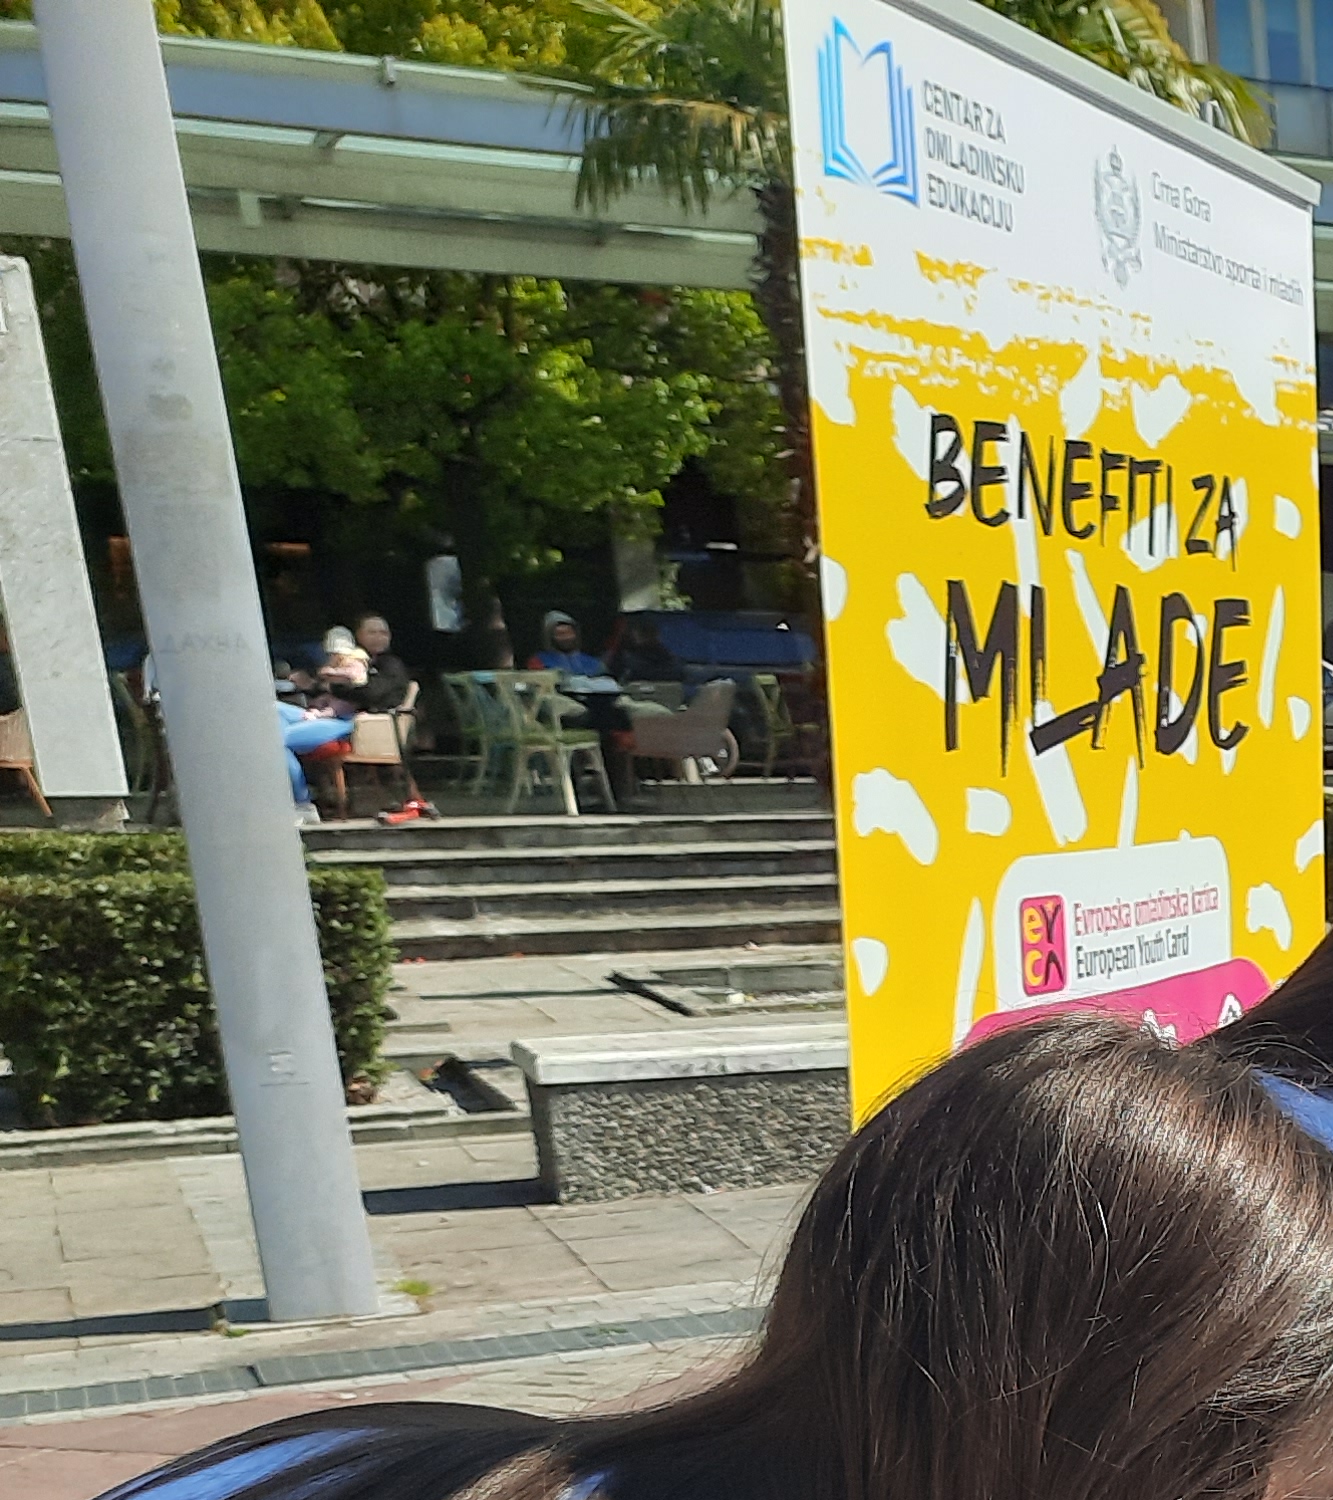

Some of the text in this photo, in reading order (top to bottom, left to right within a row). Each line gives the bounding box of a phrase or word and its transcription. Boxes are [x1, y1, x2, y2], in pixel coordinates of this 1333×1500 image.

[922, 80, 1007, 144] CENTAR ZA
[925, 127, 1025, 194] OMLADINSKU
[926, 173, 1014, 232] EDUKACIJU
[924, 412, 1238, 572] BENEFITI ZA
[943, 579, 1252, 778] MLADE
[1073, 898, 1132, 937] Evropska
[1076, 925, 1190, 980] European Youth Card
